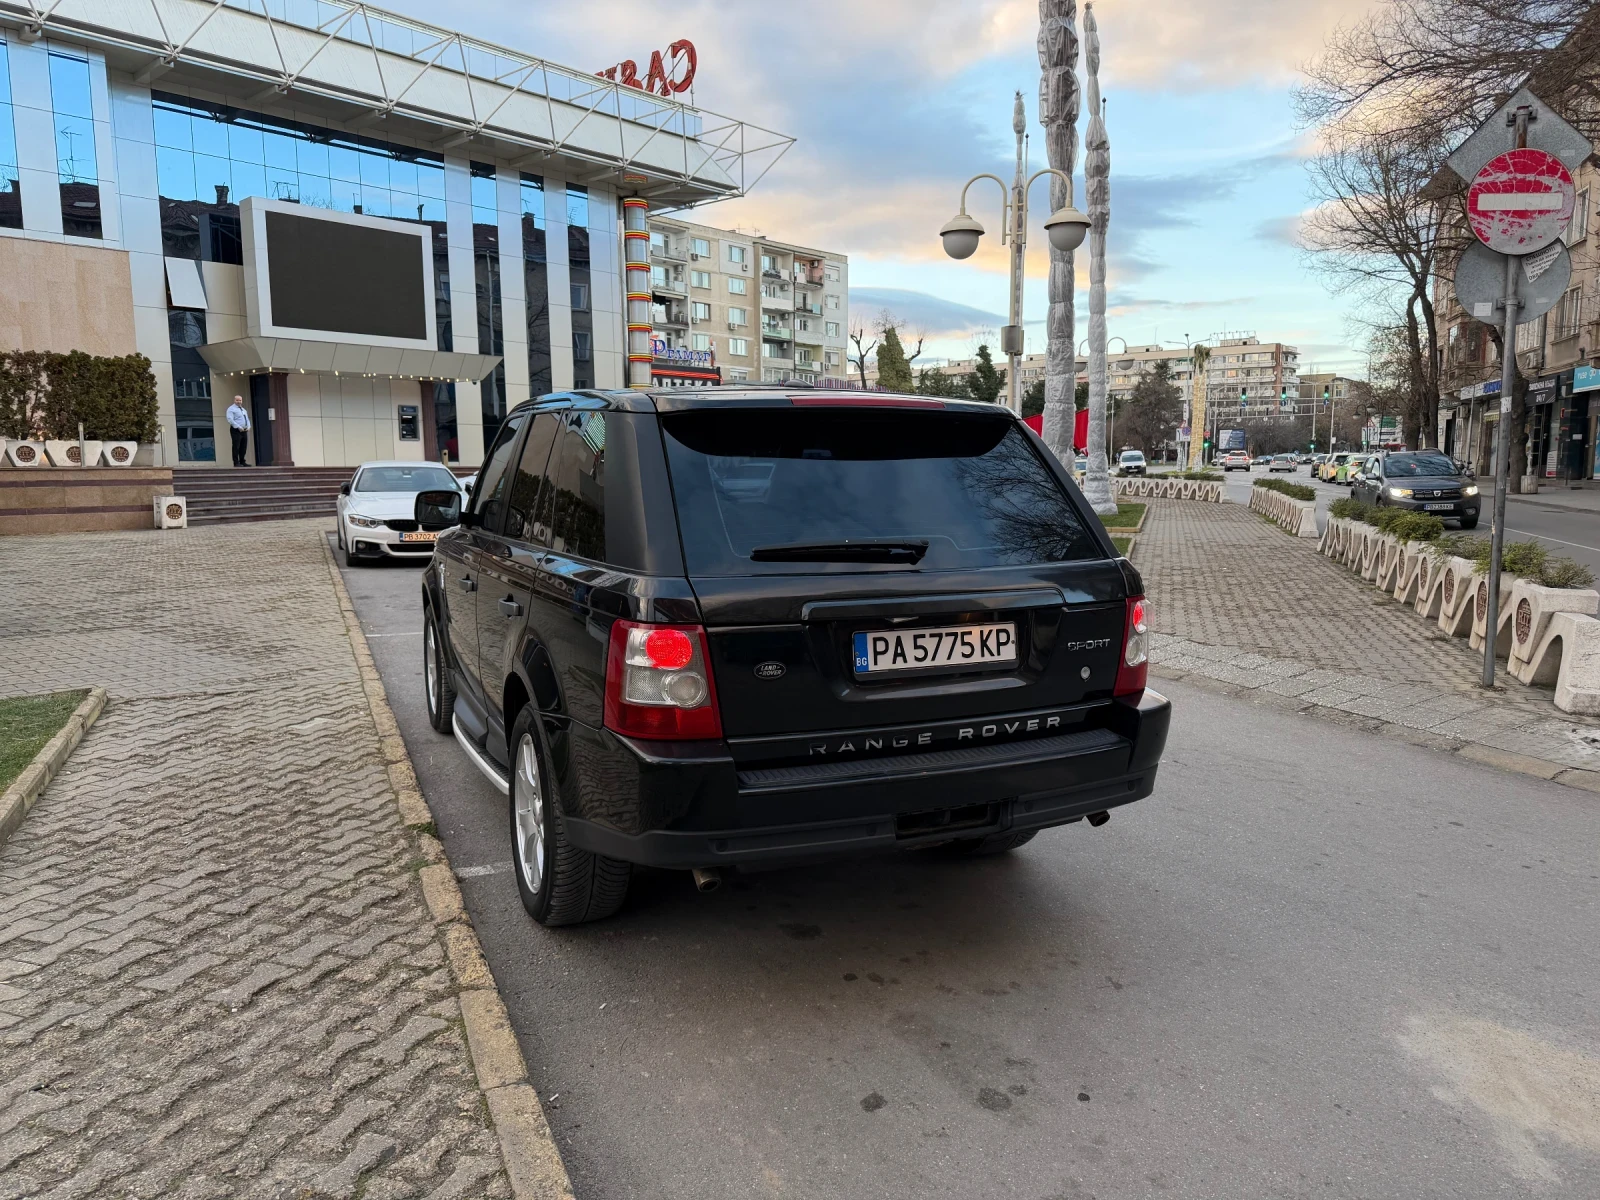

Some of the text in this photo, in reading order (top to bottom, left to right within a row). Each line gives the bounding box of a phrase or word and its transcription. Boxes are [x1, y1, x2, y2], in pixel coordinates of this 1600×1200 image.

[652, 377, 713, 388] АПТЕКА
[1067, 638, 1111, 652] SPORT
[856, 657, 868, 667] BG
[809, 716, 1062, 755] RANGE ROVER
